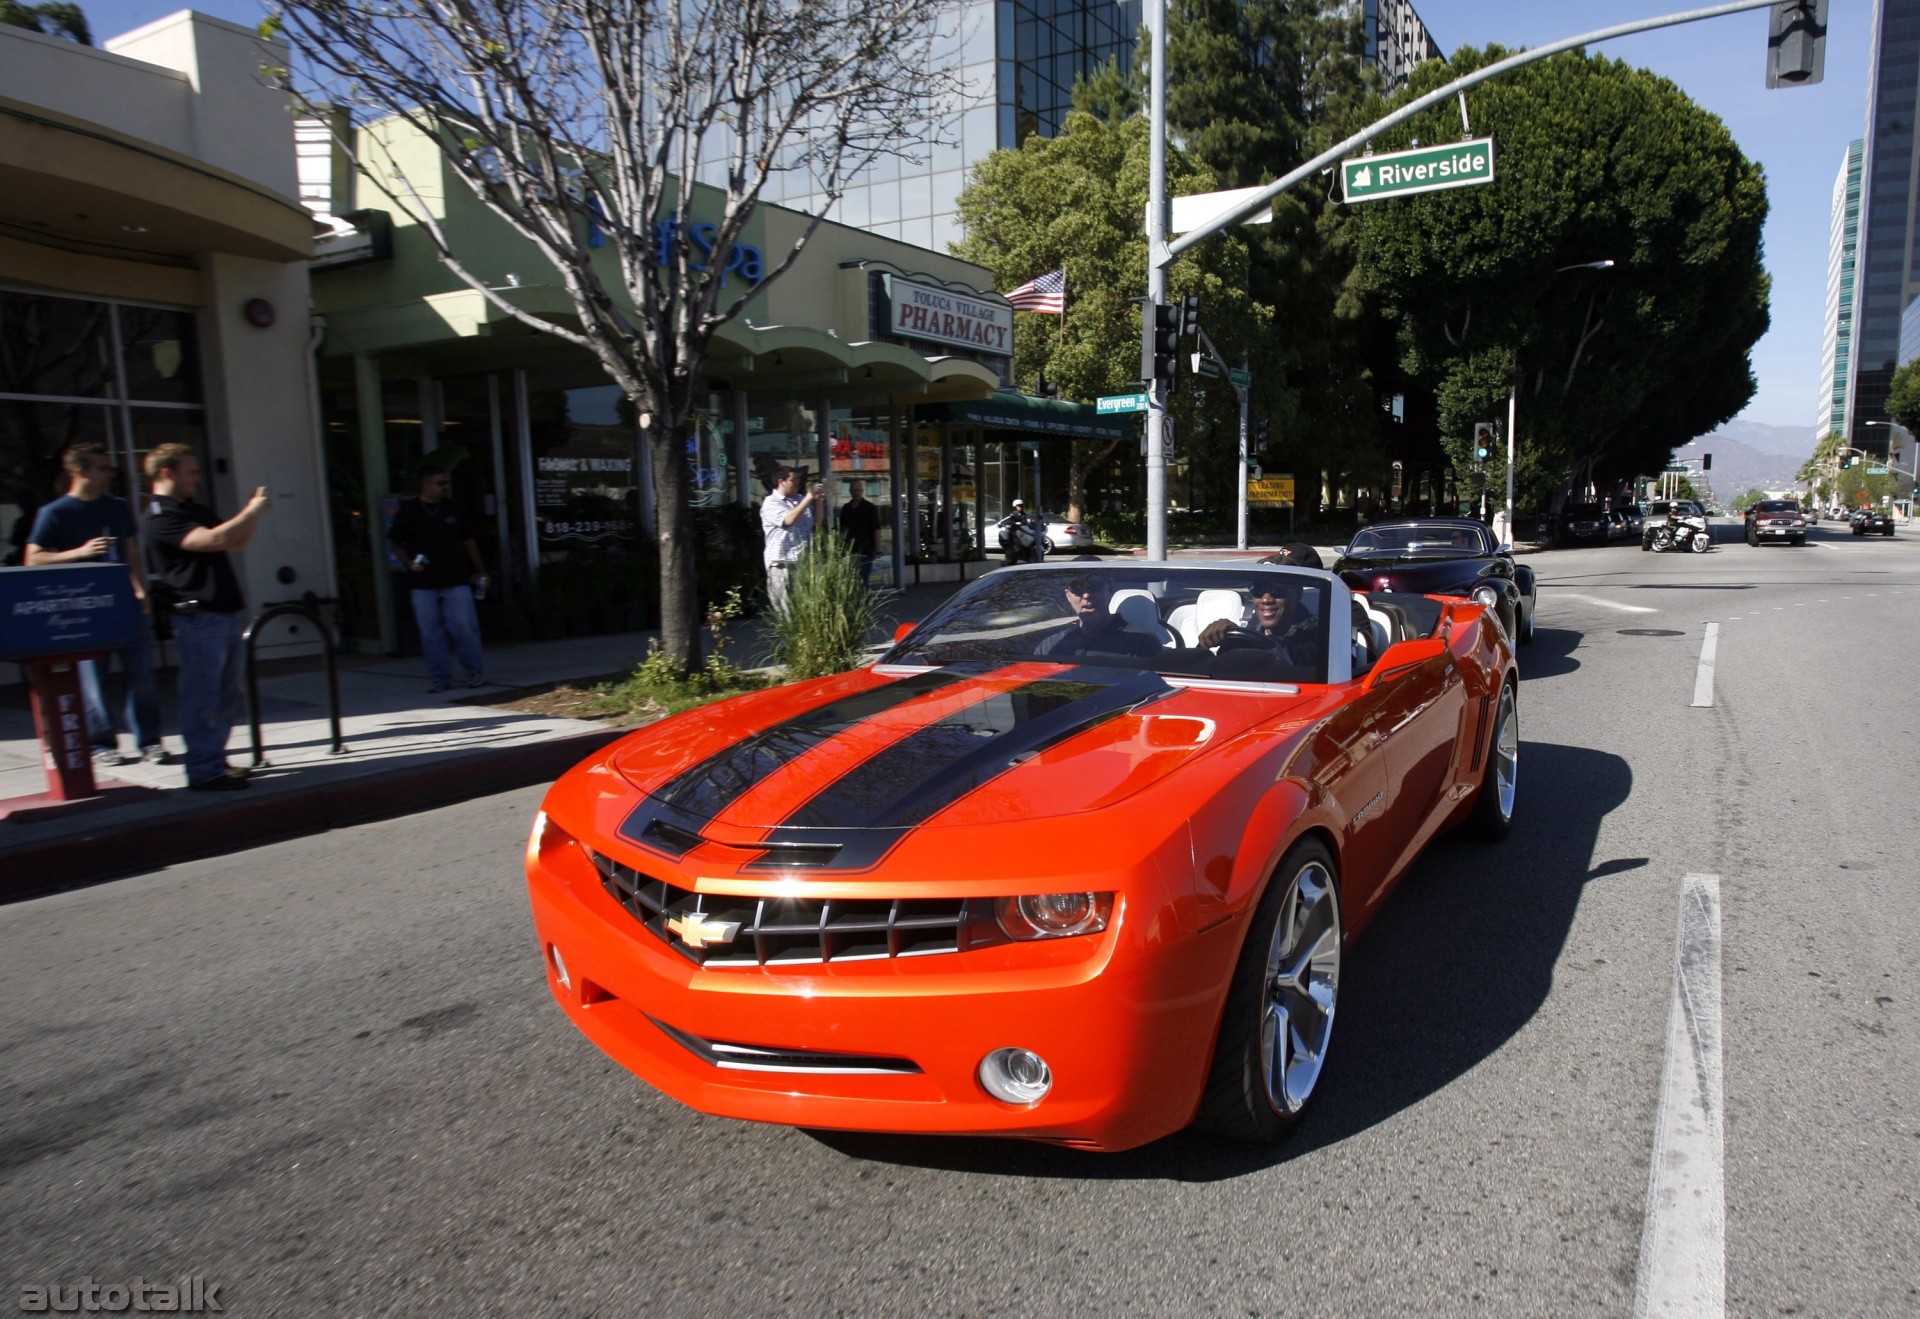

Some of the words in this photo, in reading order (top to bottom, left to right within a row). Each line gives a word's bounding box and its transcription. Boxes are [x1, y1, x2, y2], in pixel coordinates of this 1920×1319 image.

[1379, 153, 1485, 185] Riverside
[914, 290, 951, 312] TOLUCA
[956, 301, 996, 322] VILLAGE
[899, 304, 1007, 348] PHARMACY
[1097, 397, 1136, 413] Evergreen
[13, 595, 114, 614] APARTMENT
[59, 694, 82, 769] FREE
